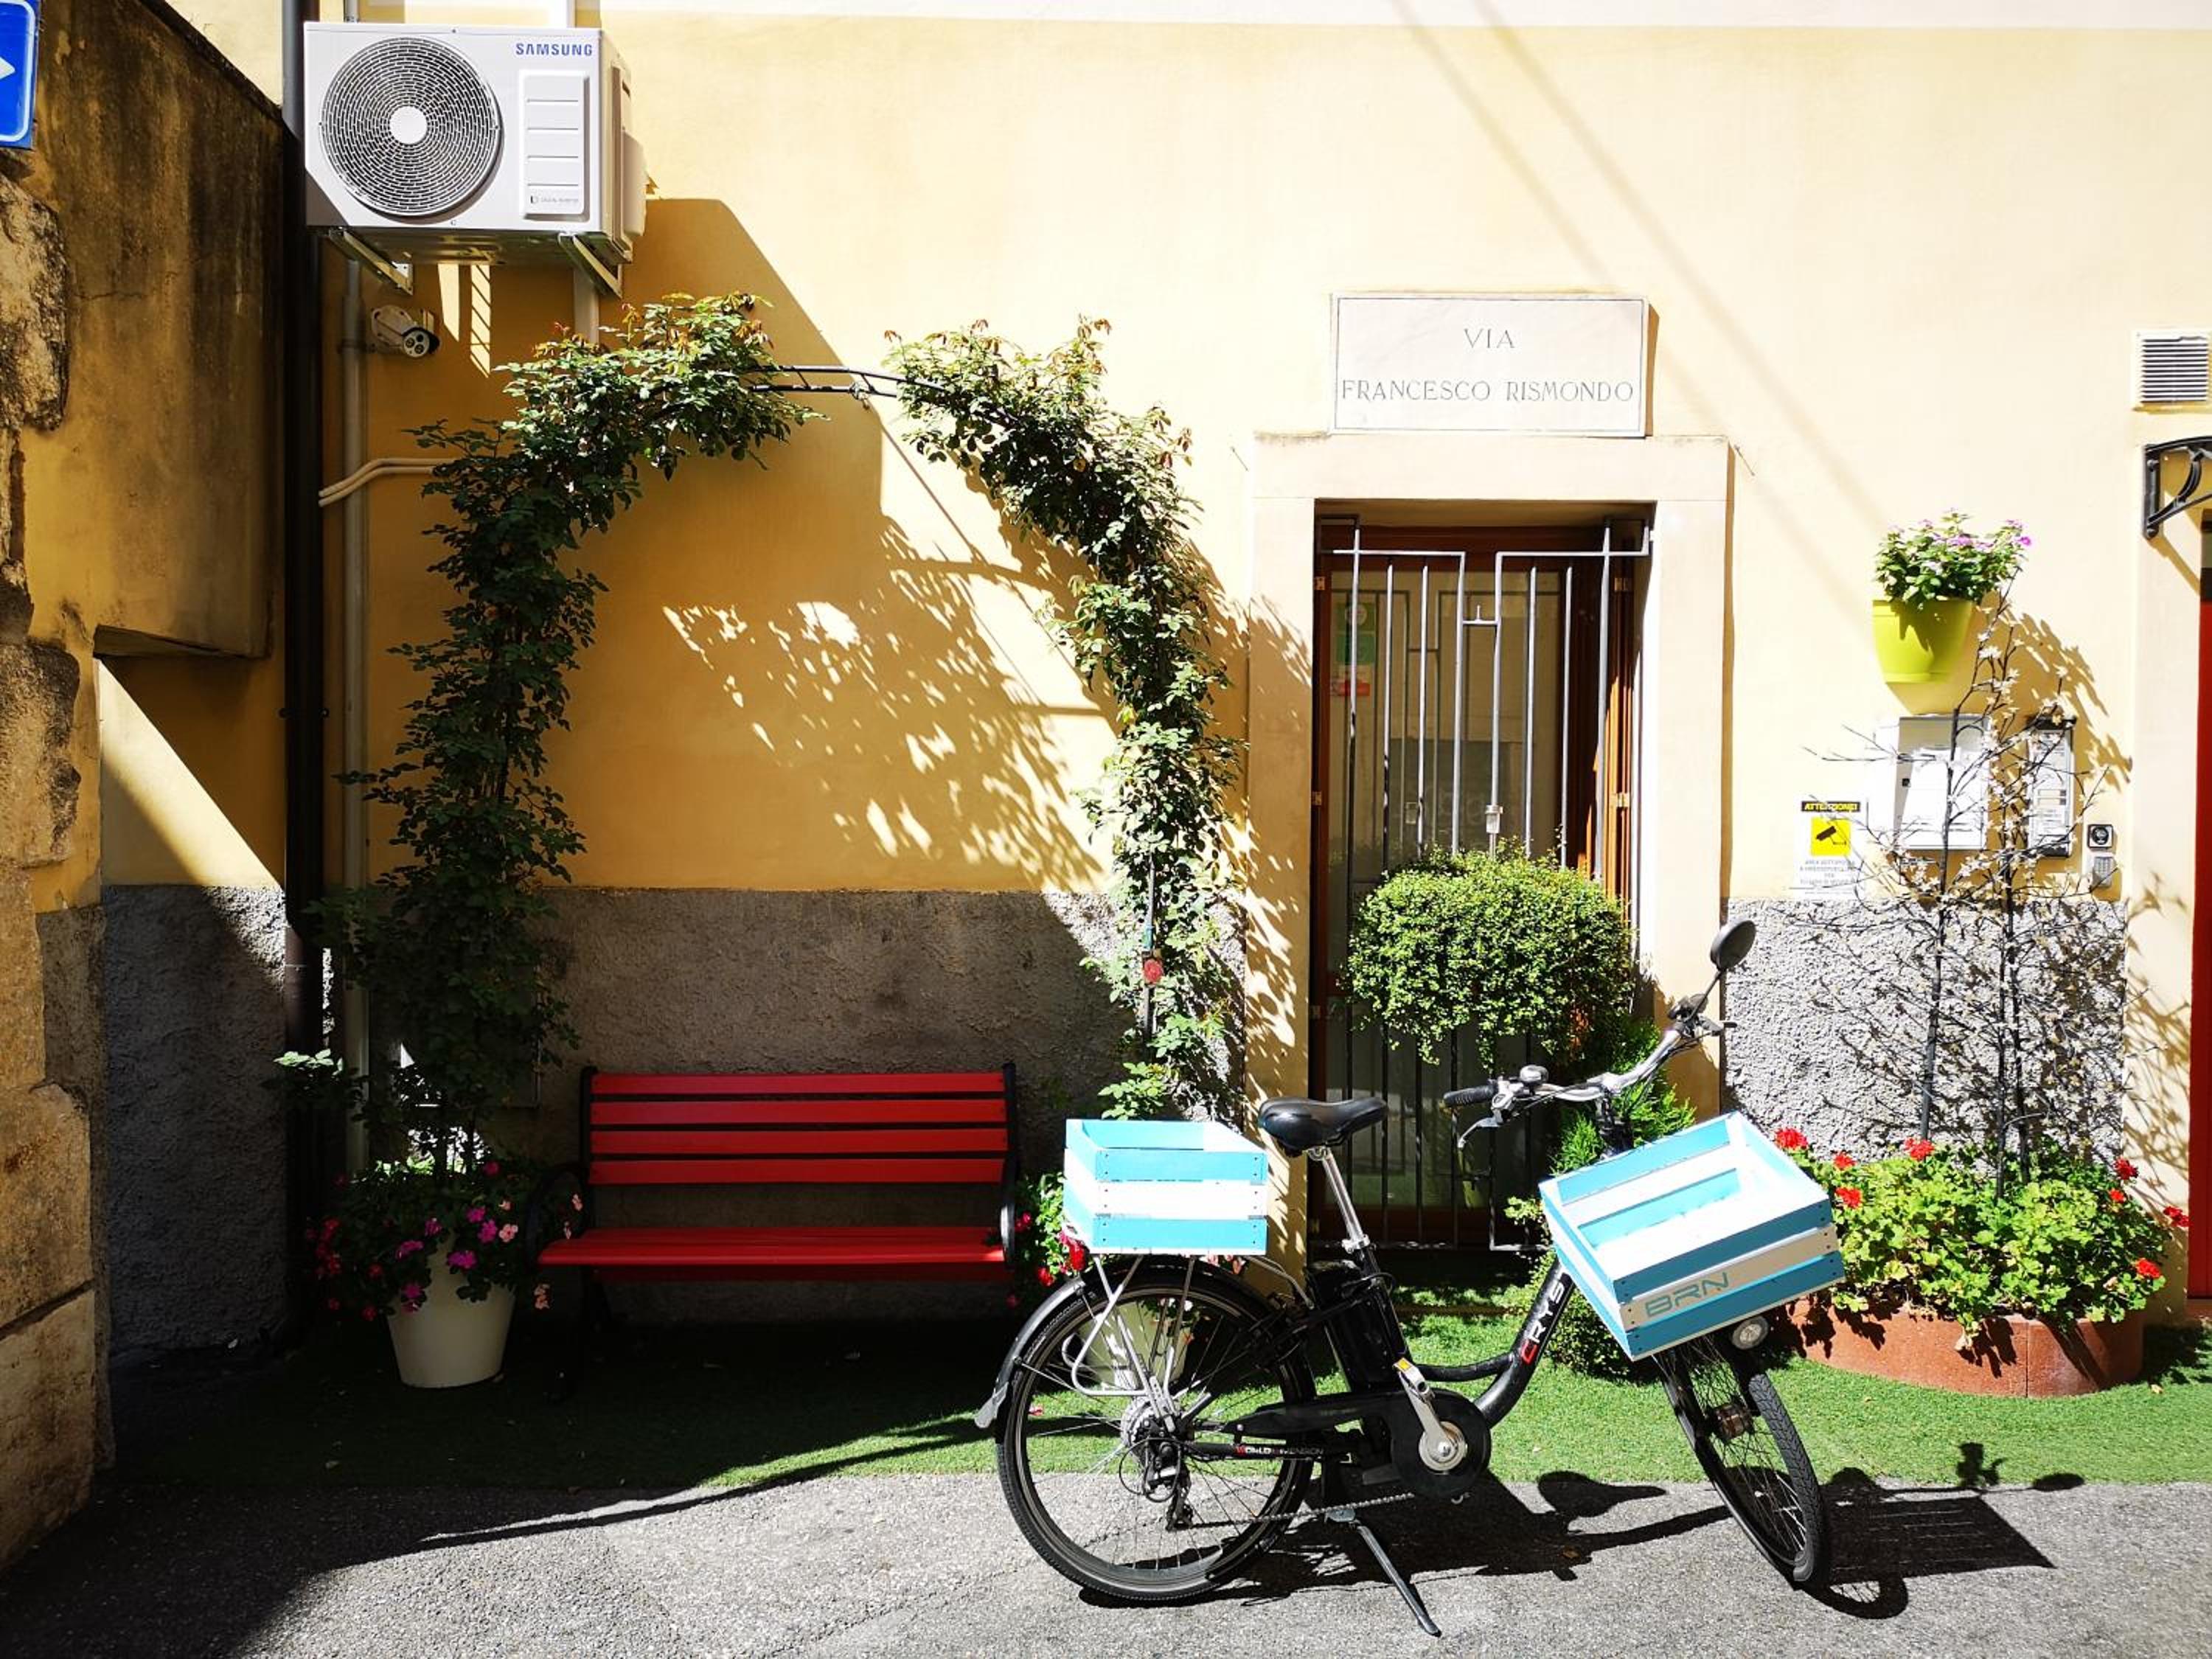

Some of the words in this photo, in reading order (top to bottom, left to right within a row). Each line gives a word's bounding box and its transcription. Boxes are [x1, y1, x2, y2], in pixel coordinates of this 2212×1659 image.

[515, 43, 593, 56] SAMSUNG
[1464, 328, 1515, 349] VIA
[1342, 380, 1491, 402] FRANCESCO
[1506, 380, 1633, 402] RISMONDO
[1645, 1271, 1729, 1317] BRN
